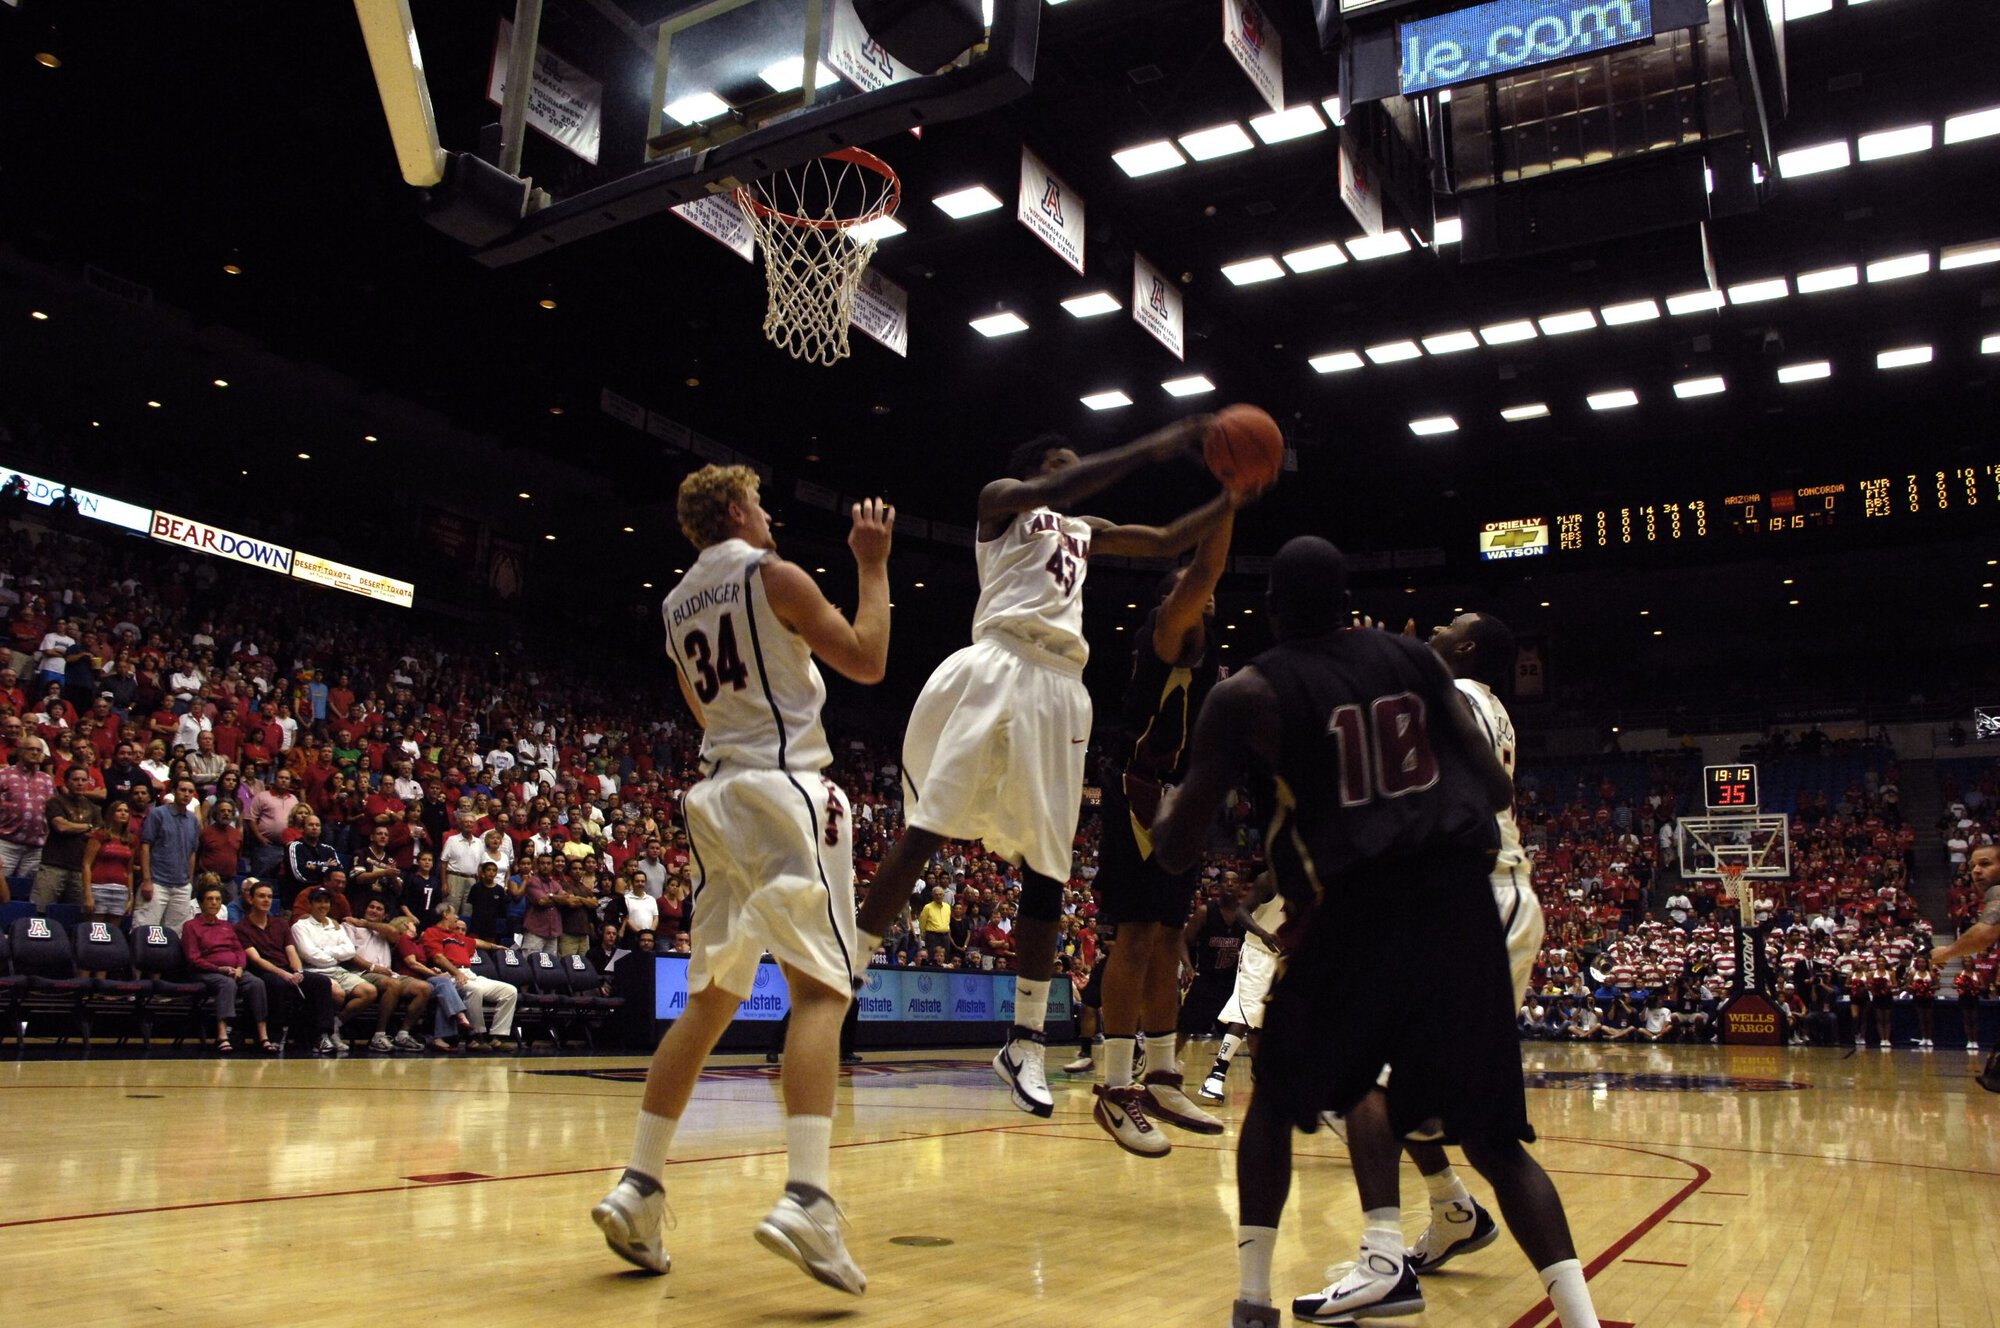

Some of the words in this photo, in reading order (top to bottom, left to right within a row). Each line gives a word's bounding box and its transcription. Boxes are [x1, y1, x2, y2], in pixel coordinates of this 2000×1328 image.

[1402, 0, 1641, 88] le.com
[1907, 475, 1916, 484] 7
[1798, 484, 1845, 497] CONCORDIA
[1866, 488, 1887, 498] PTS
[1724, 493, 1760, 506] ARIZONA
[1825, 496, 1834, 509] 0
[1866, 497, 1890, 508] RBS
[1621, 508, 1630, 518] 5
[1663, 503, 1679, 513] 34
[1688, 500, 1704, 510] 43
[1745, 505, 1754, 518] 0
[1866, 507, 1890, 517] FLS
[1485, 517, 1542, 531] O'RIELLY
[1562, 523, 1580, 533] PTS
[1561, 531, 1582, 542] RBS
[1561, 540, 1582, 550] FLS
[1487, 546, 1544, 560] WATSON
[294, 559, 321, 573] DESERT
[1046, 544, 1077, 598] 43
[359, 577, 385, 591] DESERT
[387, 584, 412, 598] TOYOTA
[673, 582, 740, 627] BUDINGER
[684, 612, 748, 704] 34
[1719, 784, 1746, 804] 35
[424, 888, 433, 911] 7
[1742, 932, 1756, 989] ARIZONA
[1728, 1013, 1775, 1023] WELLS
[1730, 1024, 1775, 1034] FARGO
